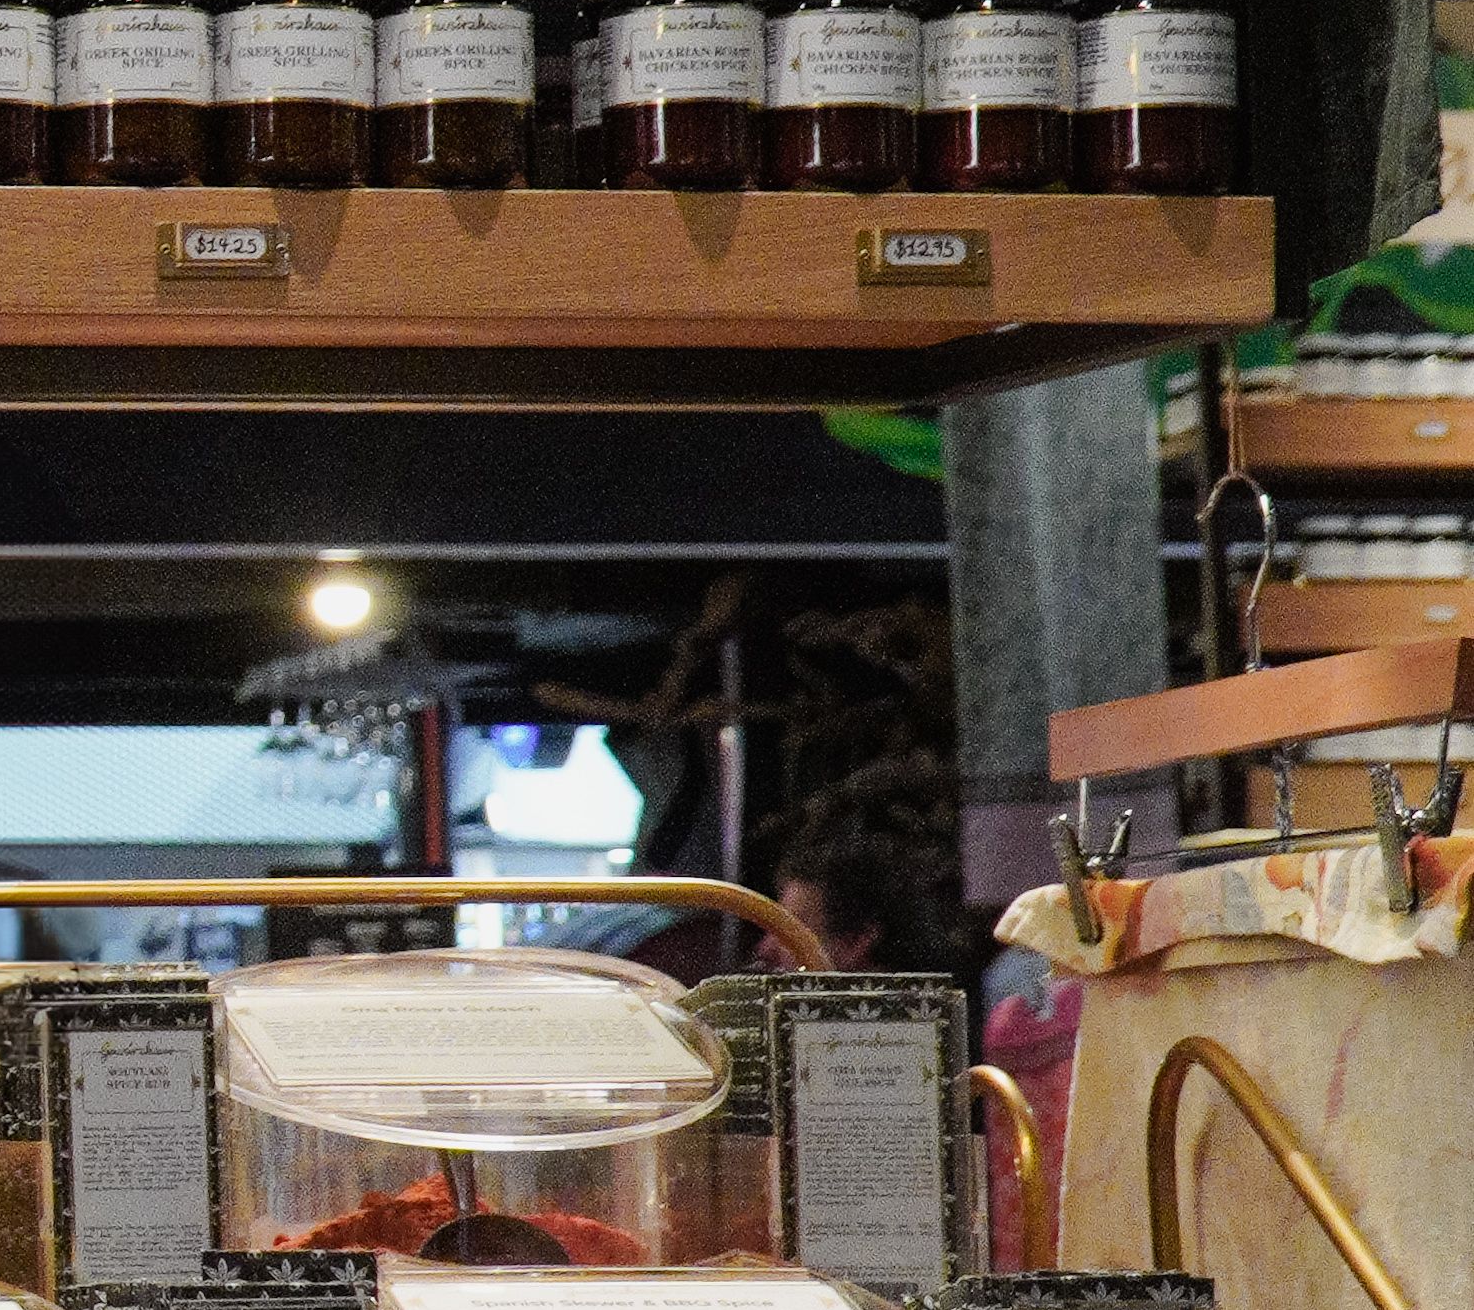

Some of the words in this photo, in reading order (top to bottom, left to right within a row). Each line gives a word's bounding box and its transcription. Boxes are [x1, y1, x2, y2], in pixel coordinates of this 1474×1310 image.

[84, 47, 129, 61] GREEK
[132, 47, 195, 61] GRILLING
[638, 46, 711, 63] BAVARIAN
[122, 57, 164, 70] SPICE
[644, 59, 709, 74] CHICKEN
[194, 237, 258, 256] $14.25
[470, 1297, 554, 1309] Spanish
[559, 1297, 635, 1308] Skewer
[643, 1297, 656, 1308] &
[717, 1297, 775, 1309] Spice
